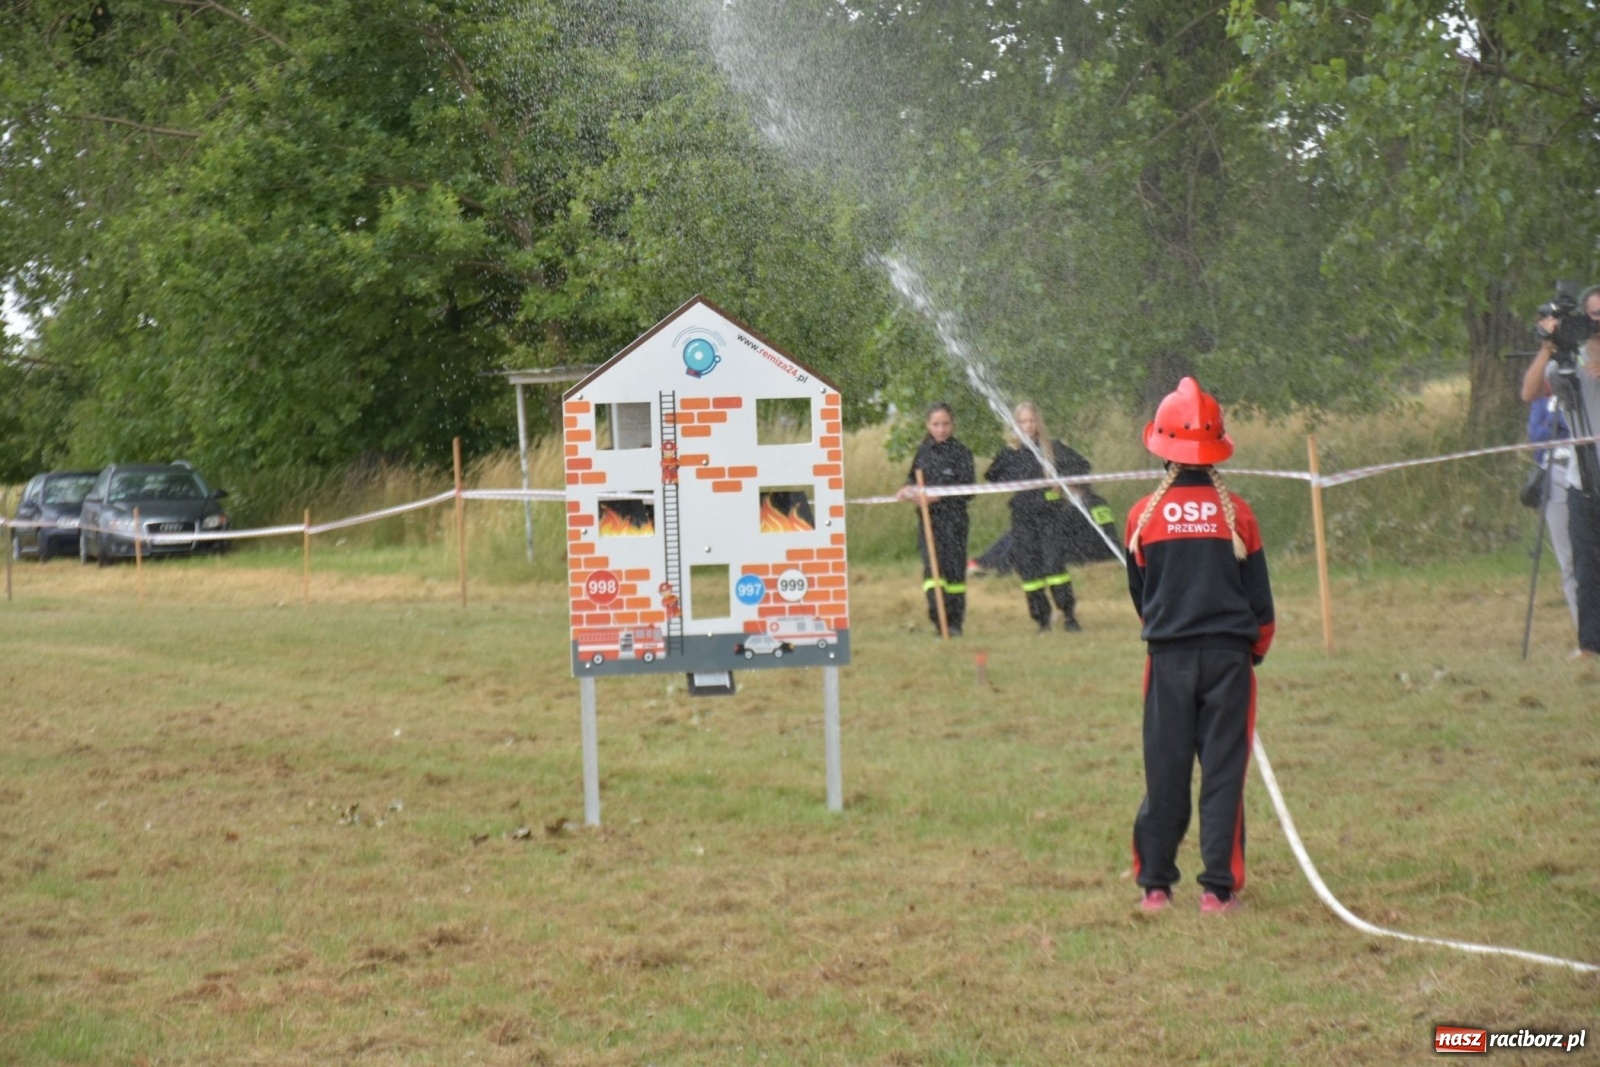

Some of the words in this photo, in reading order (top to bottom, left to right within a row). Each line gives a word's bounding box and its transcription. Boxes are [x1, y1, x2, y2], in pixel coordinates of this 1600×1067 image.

[737, 333, 808, 383] www.remiza24.pl
[1163, 501, 1218, 522] OSP
[588, 580, 616, 594] 998
[738, 584, 762, 597] 997
[780, 579, 805, 592] 999
